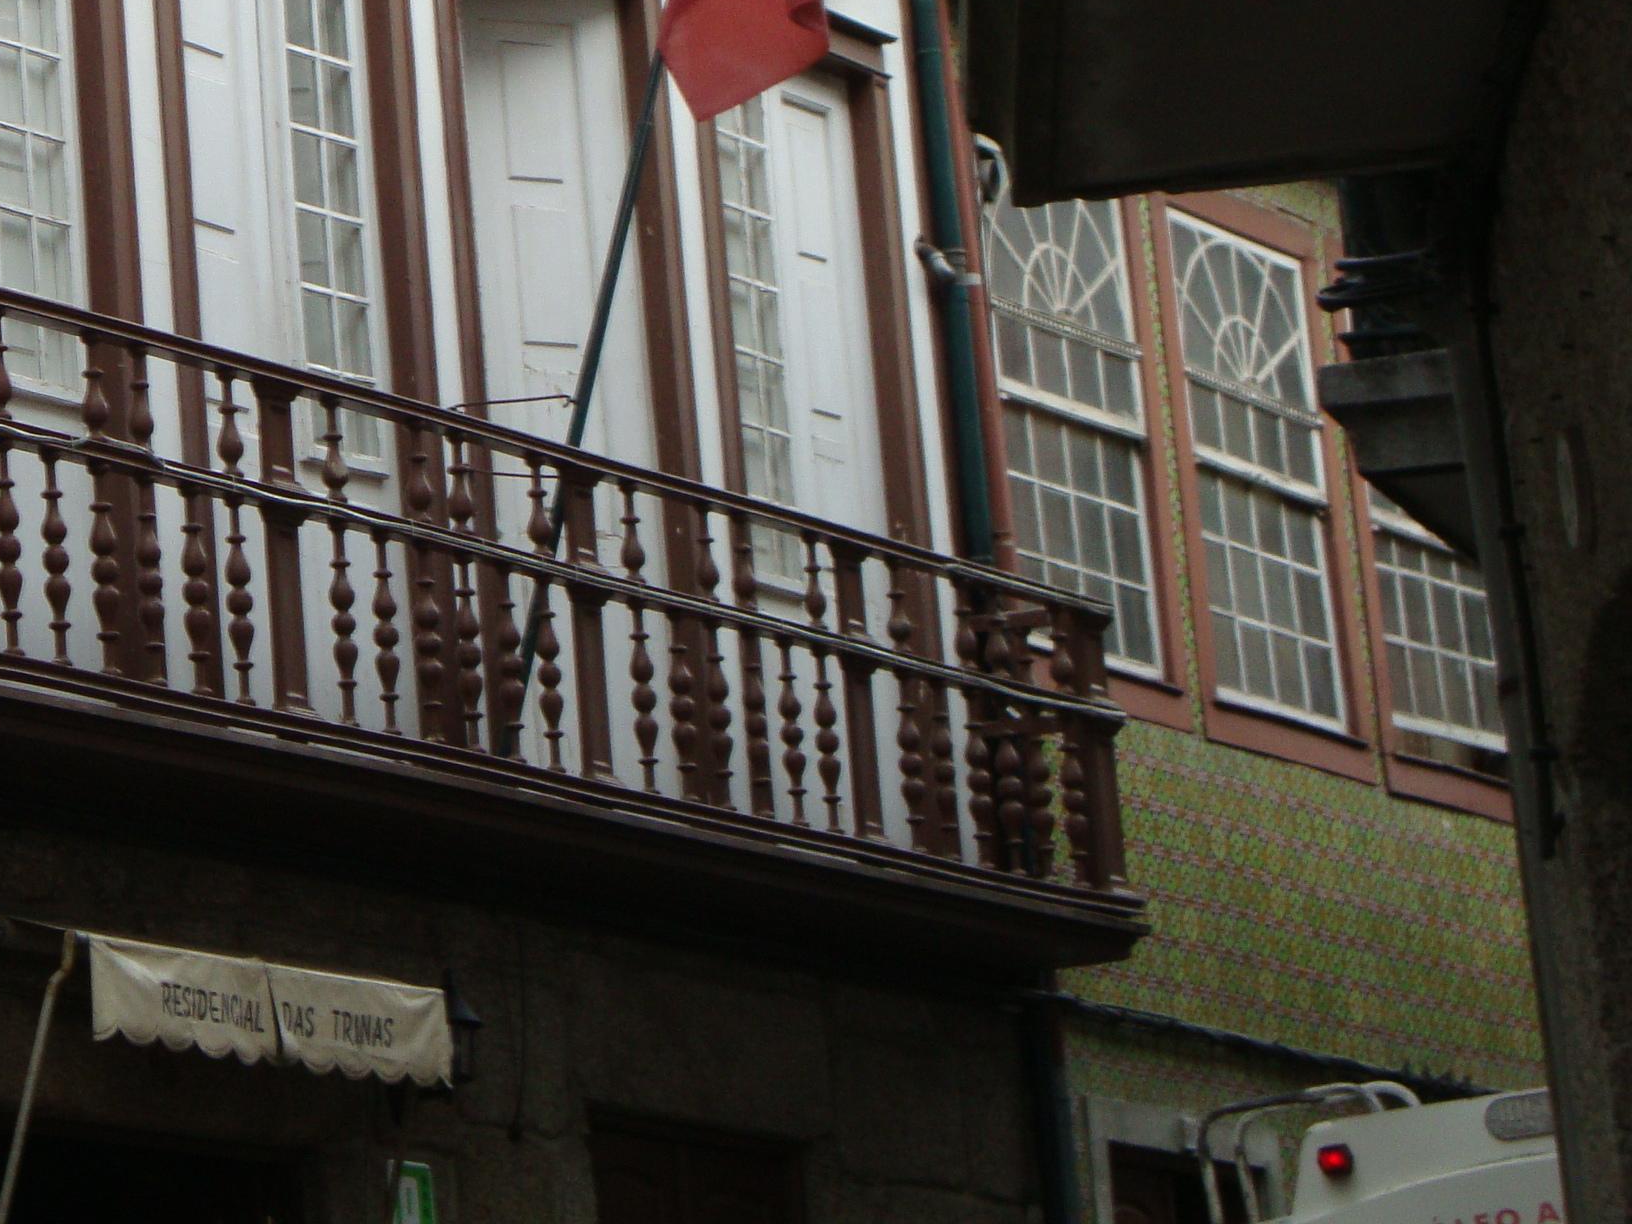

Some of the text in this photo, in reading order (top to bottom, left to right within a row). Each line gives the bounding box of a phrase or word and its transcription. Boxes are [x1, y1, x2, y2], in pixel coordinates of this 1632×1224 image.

[161, 982, 394, 1048] RESIDENCIAL DAS TRINAS
